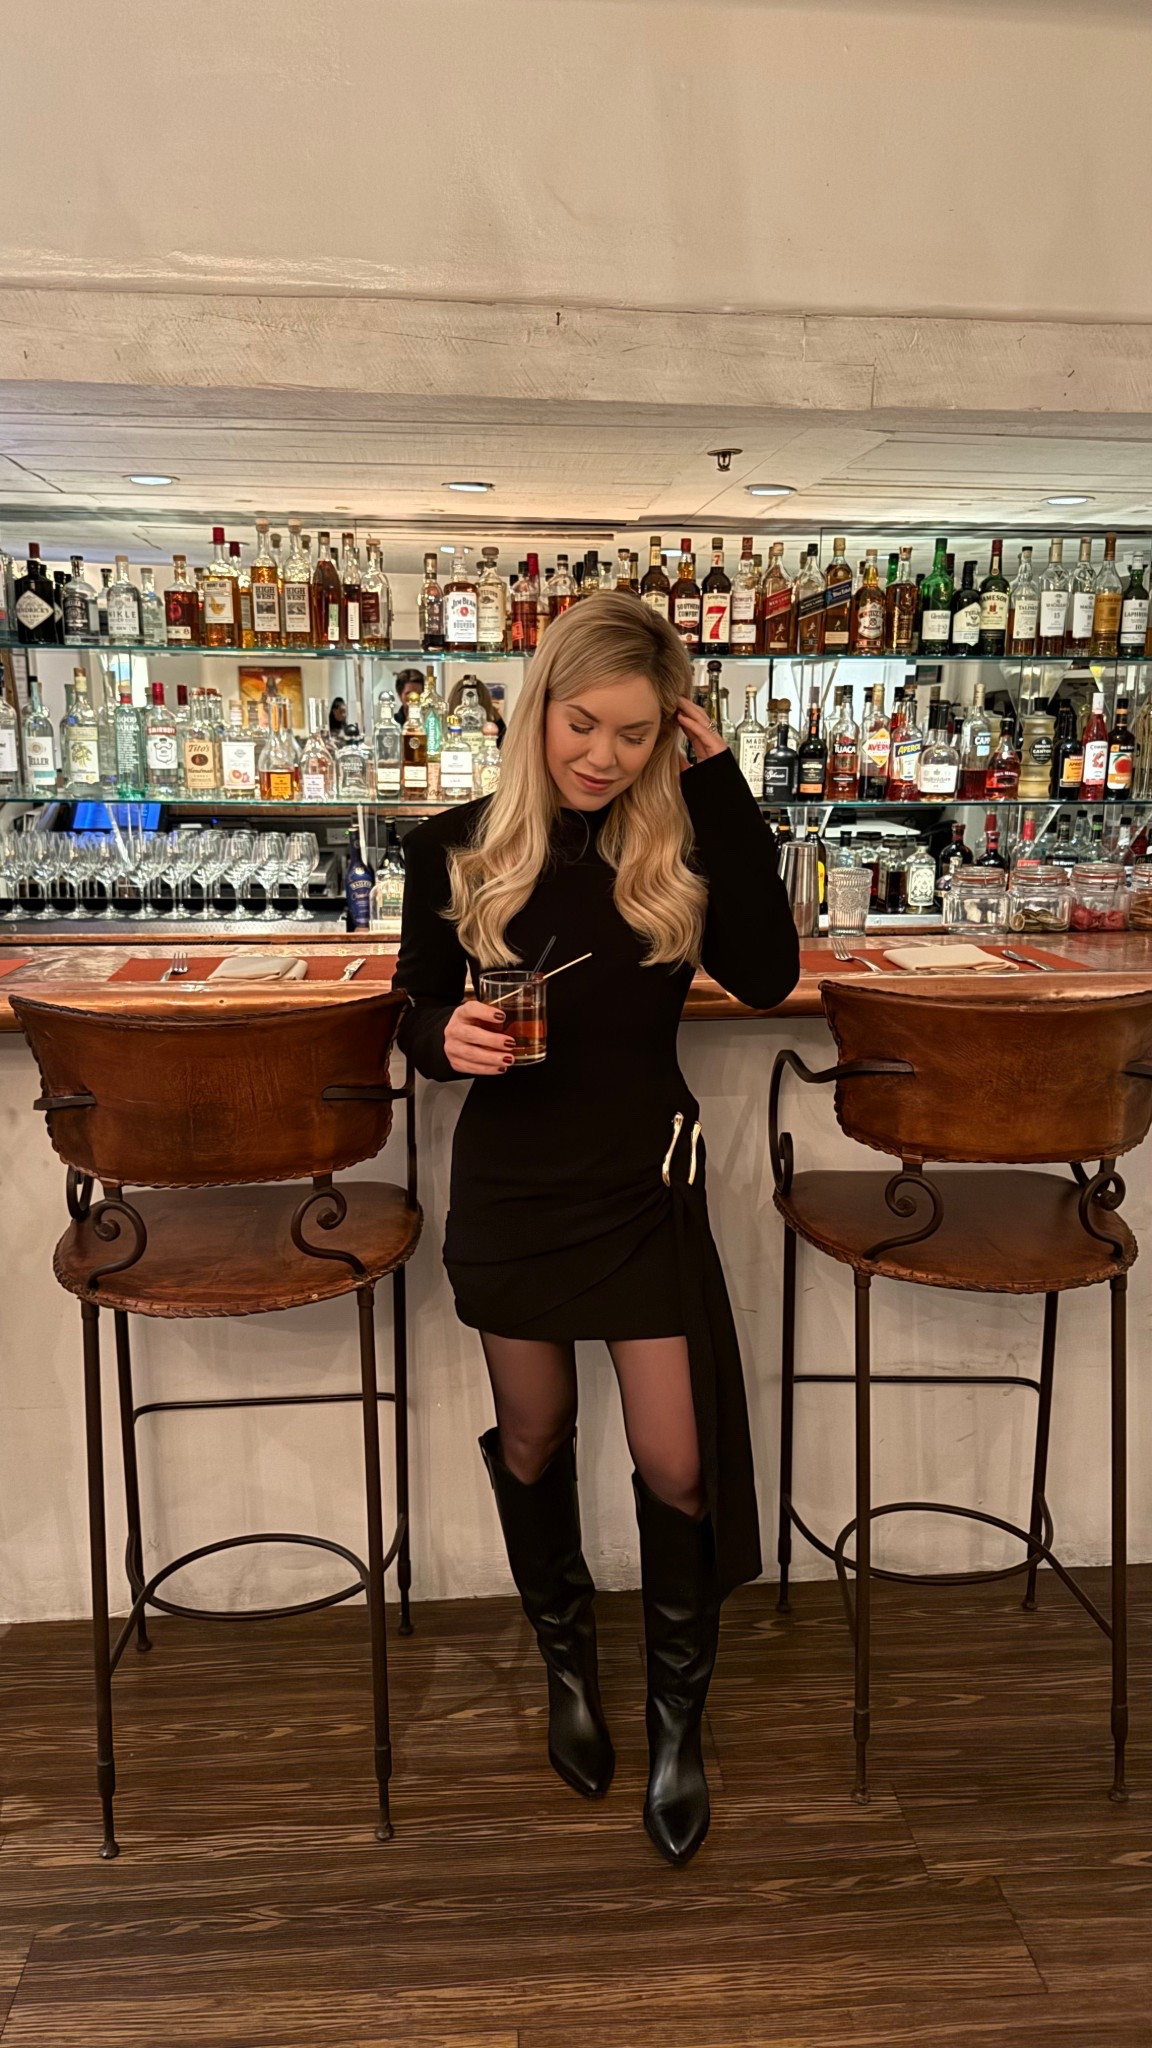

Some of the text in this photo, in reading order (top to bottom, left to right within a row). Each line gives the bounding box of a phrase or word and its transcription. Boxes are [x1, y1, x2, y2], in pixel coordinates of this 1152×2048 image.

[714, 554, 721, 566] 7
[287, 587, 305, 595] HIGH
[706, 605, 728, 640] 7
[188, 744, 210, 753] Tito's
[834, 743, 856, 754] TUACA
[867, 743, 891, 752] AVERN
